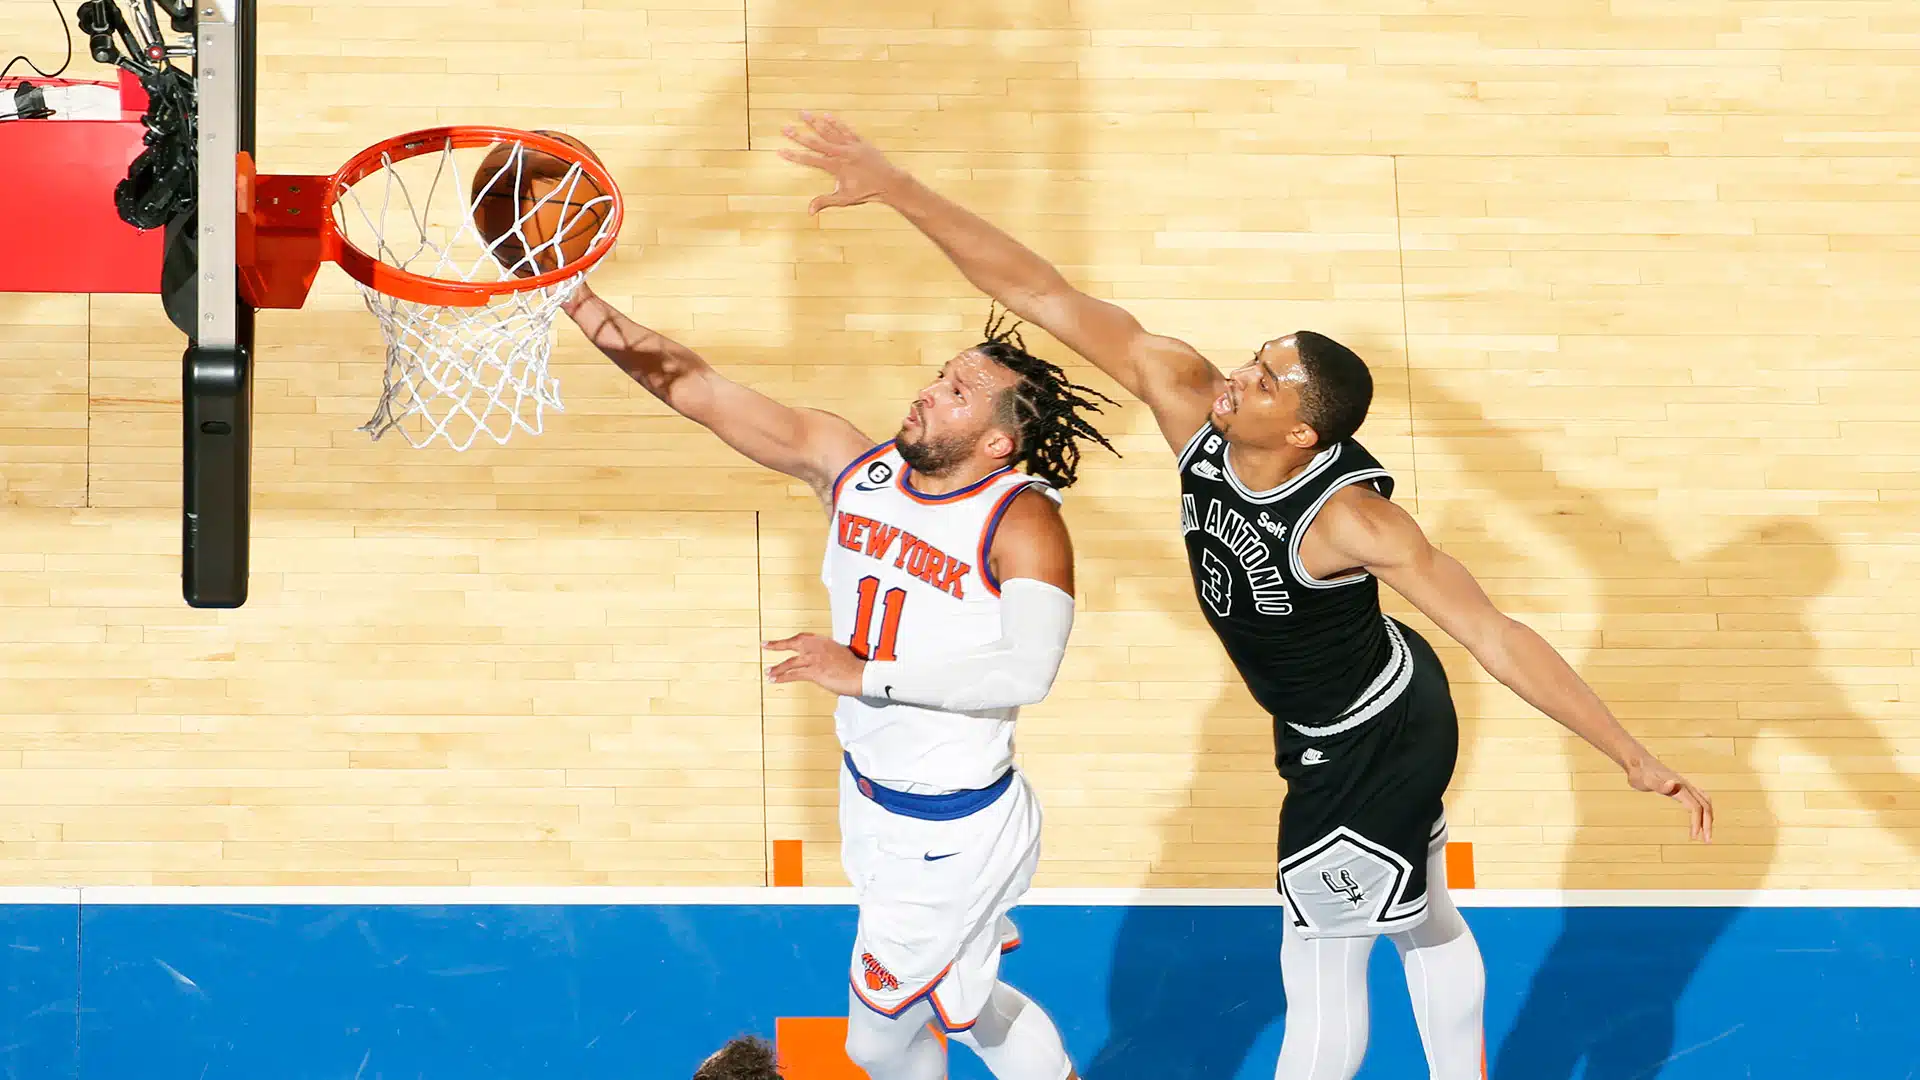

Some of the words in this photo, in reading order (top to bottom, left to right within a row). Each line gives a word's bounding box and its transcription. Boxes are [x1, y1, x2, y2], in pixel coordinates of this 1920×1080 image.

[1203, 434, 1222, 455] 6
[869, 464, 890, 482] 6
[1197, 459, 1221, 478] NIKE
[1257, 511, 1288, 542] Self.
[838, 510, 900, 560] NEW
[894, 531, 971, 600] YORK
[1204, 498, 1293, 616] ANTONIO
[1201, 548, 1232, 617] 3
[848, 575, 907, 661] 11
[861, 952, 899, 990] KNICKS
